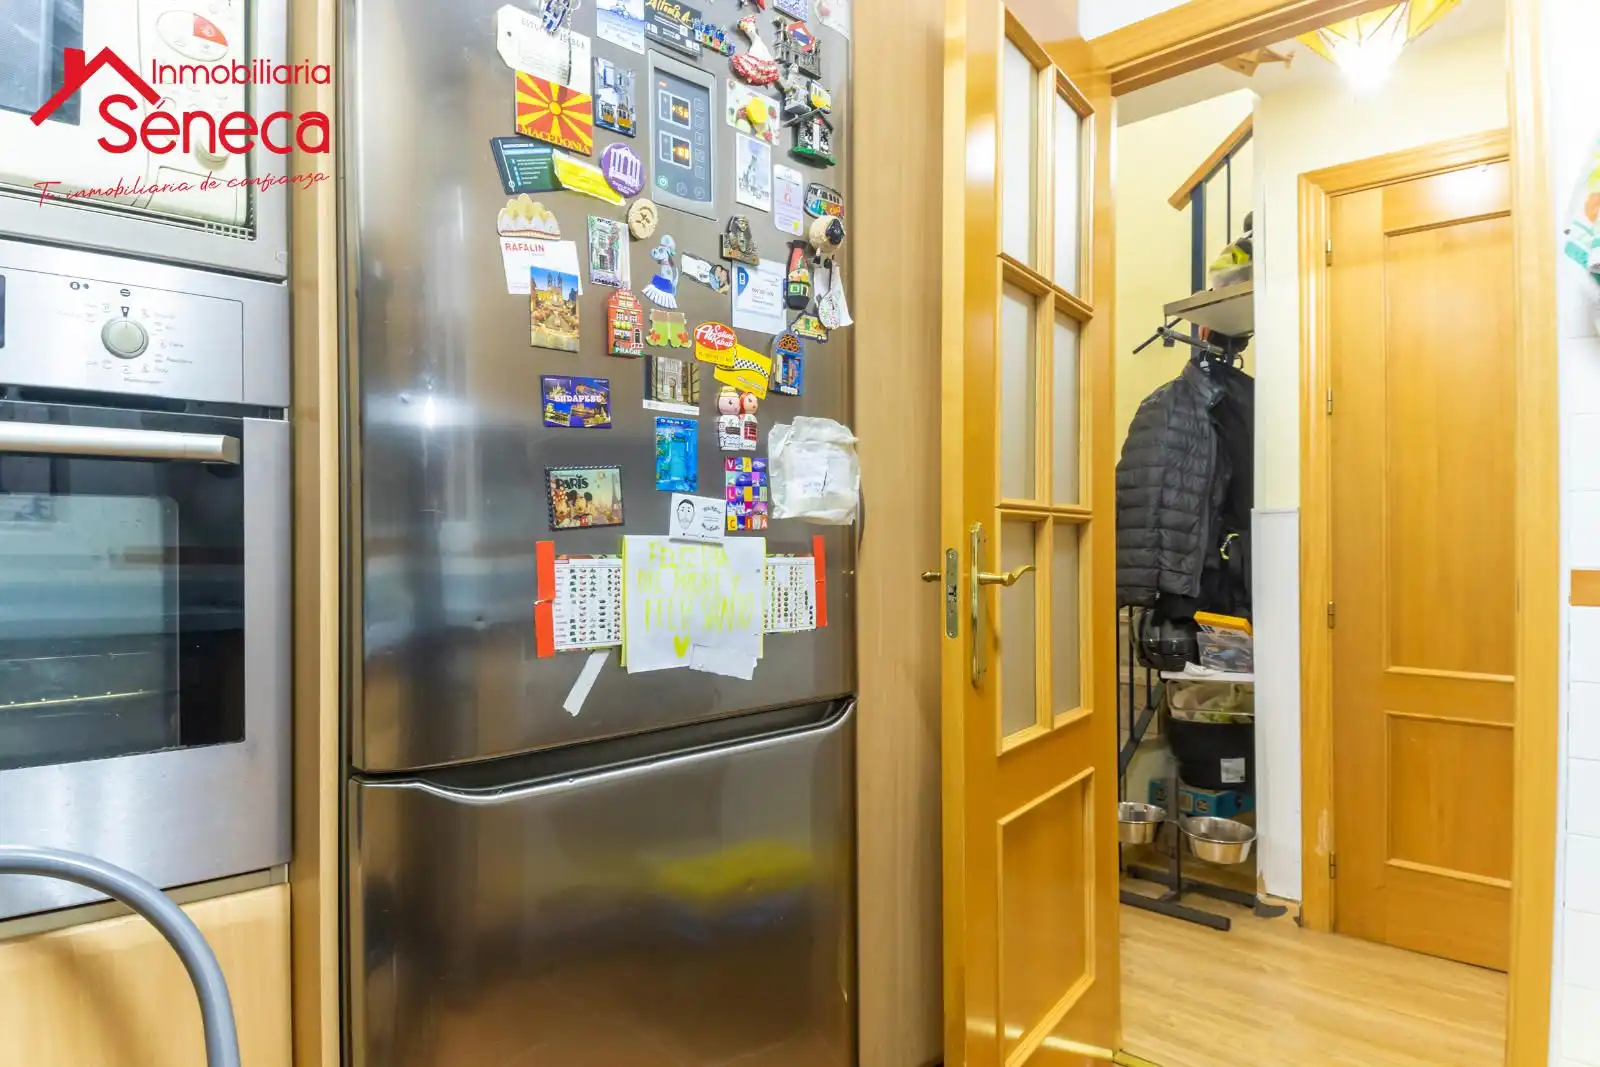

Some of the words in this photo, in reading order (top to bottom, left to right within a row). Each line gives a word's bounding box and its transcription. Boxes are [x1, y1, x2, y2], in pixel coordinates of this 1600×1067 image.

[518, 125, 591, 156] MACEDONIA
[504, 242, 545, 252] RAFALIN
[615, 346, 642, 356] PRAGUE
[553, 394, 603, 403] BUDAPEST
[555, 474, 589, 490] PARIS
